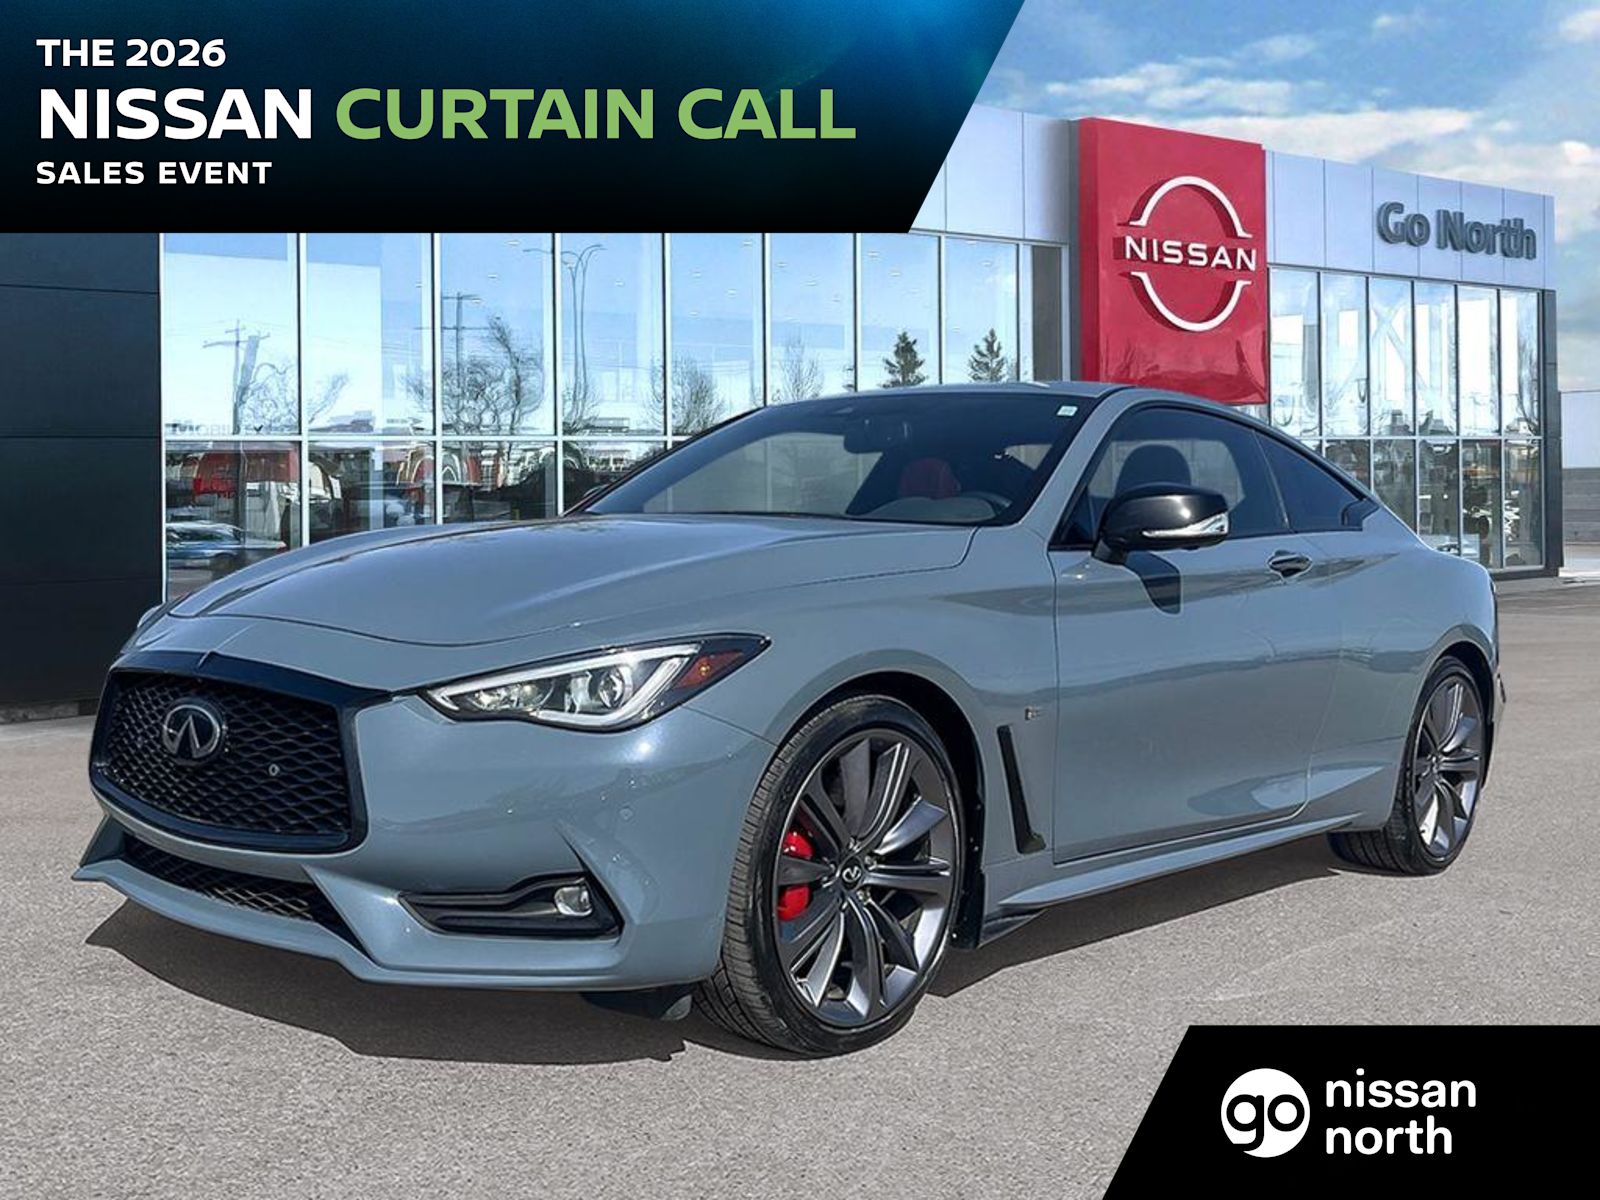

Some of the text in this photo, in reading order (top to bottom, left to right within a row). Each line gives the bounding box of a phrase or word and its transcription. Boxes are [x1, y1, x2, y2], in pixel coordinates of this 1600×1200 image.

[1125, 235, 1257, 271] NISSAN
[1378, 202, 1537, 260] Go North
